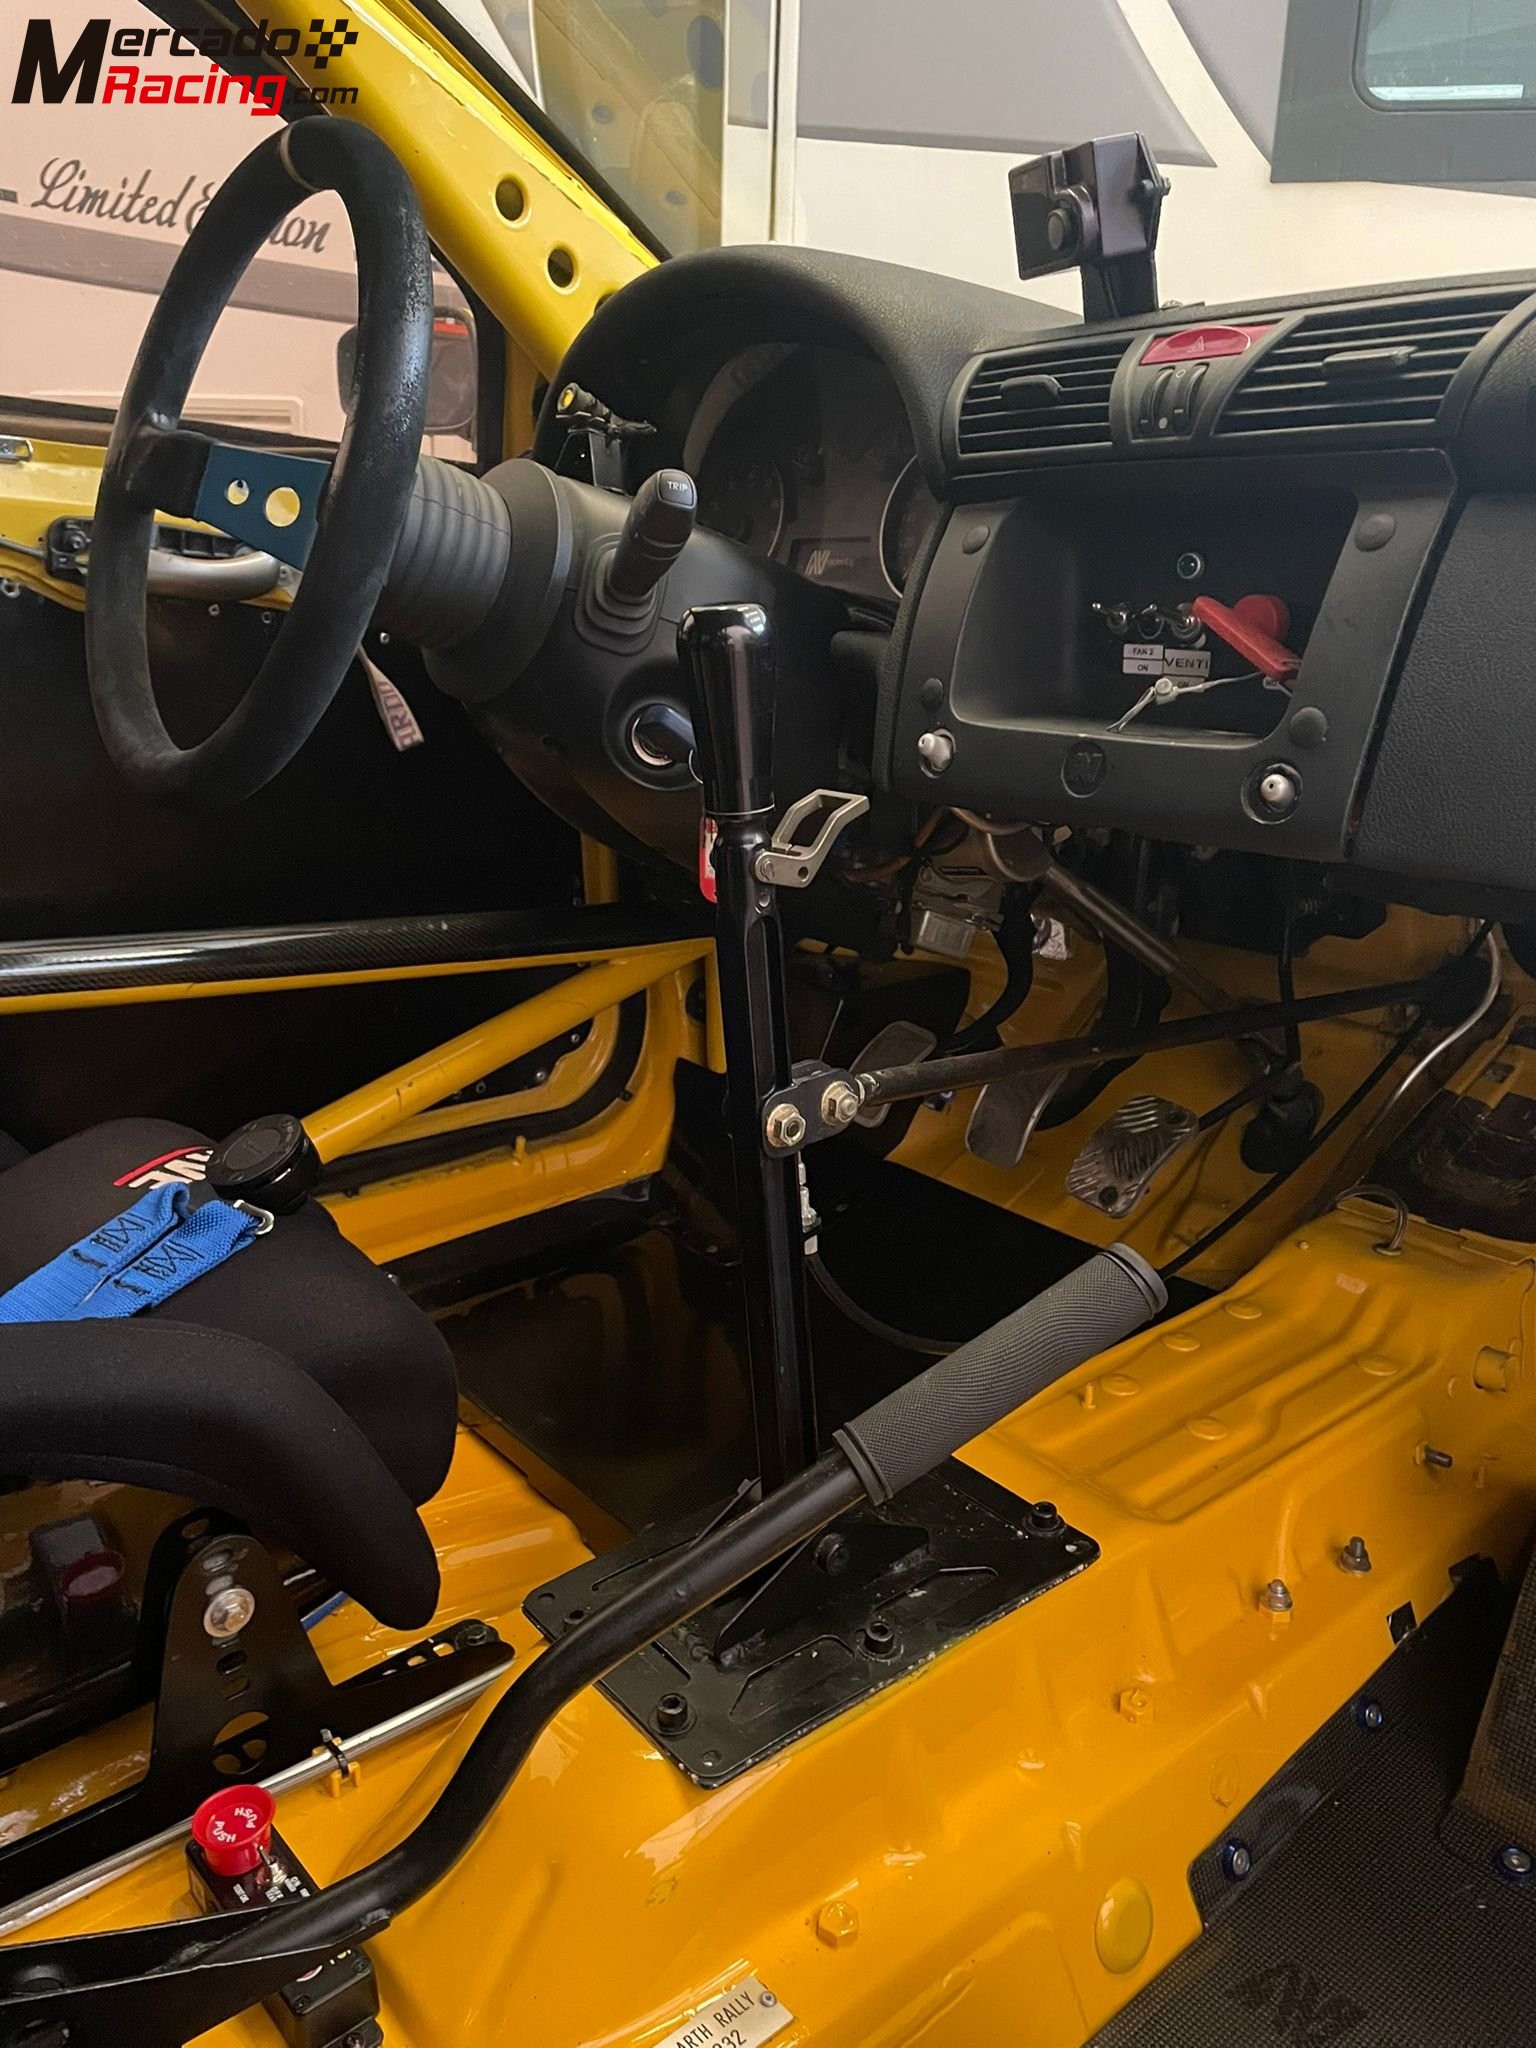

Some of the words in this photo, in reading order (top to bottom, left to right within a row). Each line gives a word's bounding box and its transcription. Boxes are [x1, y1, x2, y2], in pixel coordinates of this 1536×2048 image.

[31, 157, 197, 228] Limited
[667, 480, 688, 491] TRIP
[1132, 647, 1148, 656] FAN
[1137, 664, 1149, 672] ON
[1164, 657, 1209, 670] VENTI
[234, 1807, 257, 1828] PUSH
[213, 1821, 236, 1842] PUSH
[713, 1991, 755, 2027] RALLY
